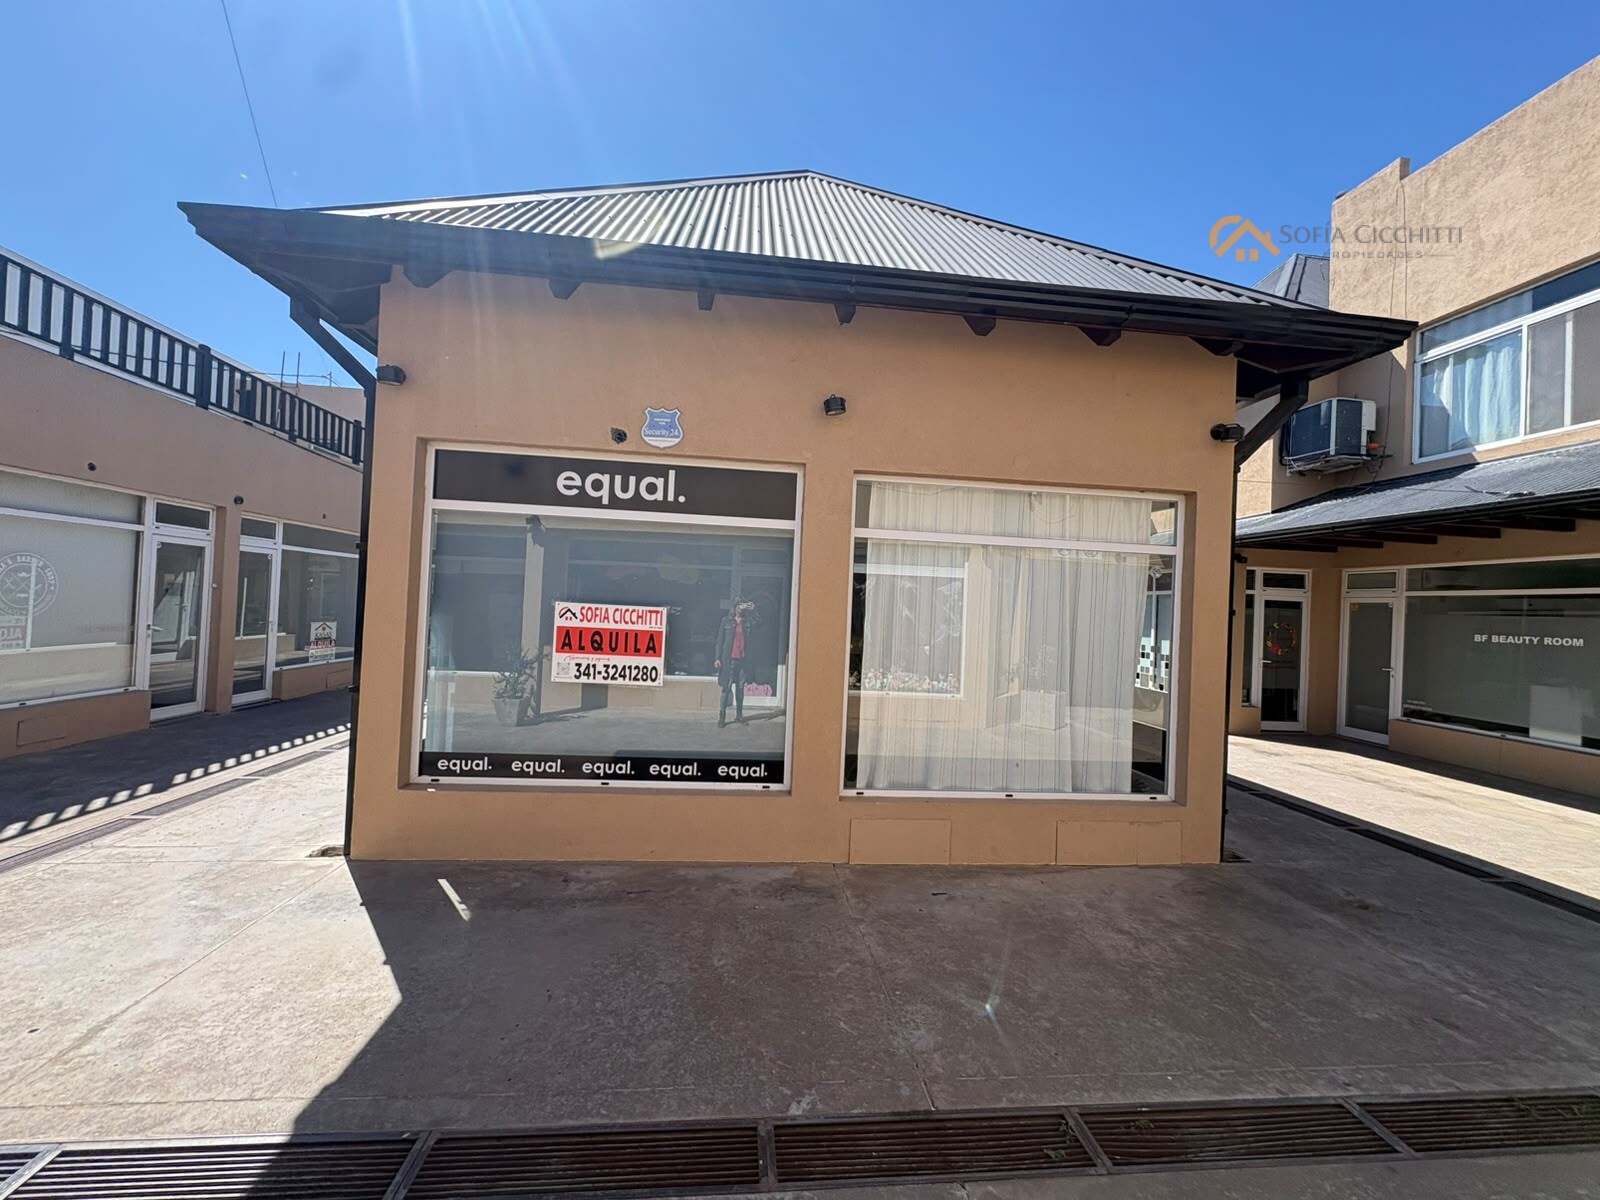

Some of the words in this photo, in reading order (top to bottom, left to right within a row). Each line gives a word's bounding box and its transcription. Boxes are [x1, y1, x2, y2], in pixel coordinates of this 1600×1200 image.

[556, 469, 686, 505] equal.
[579, 606, 610, 624] SOFIA
[612, 608, 663, 626] CICCHITTI
[311, 640, 336, 649] ALQUILA
[560, 629, 657, 654] ALQUILA
[1474, 634, 1488, 642] BF
[1491, 635, 1540, 644] BEAUTY
[1543, 637, 1584, 647] ROOM
[574, 663, 658, 682] 341-3241280
[437, 757, 492, 774] equal.
[511, 759, 565, 775] equal.
[582, 760, 635, 776] equal.
[650, 762, 701, 778] equal.
[717, 764, 768, 779] equal.
